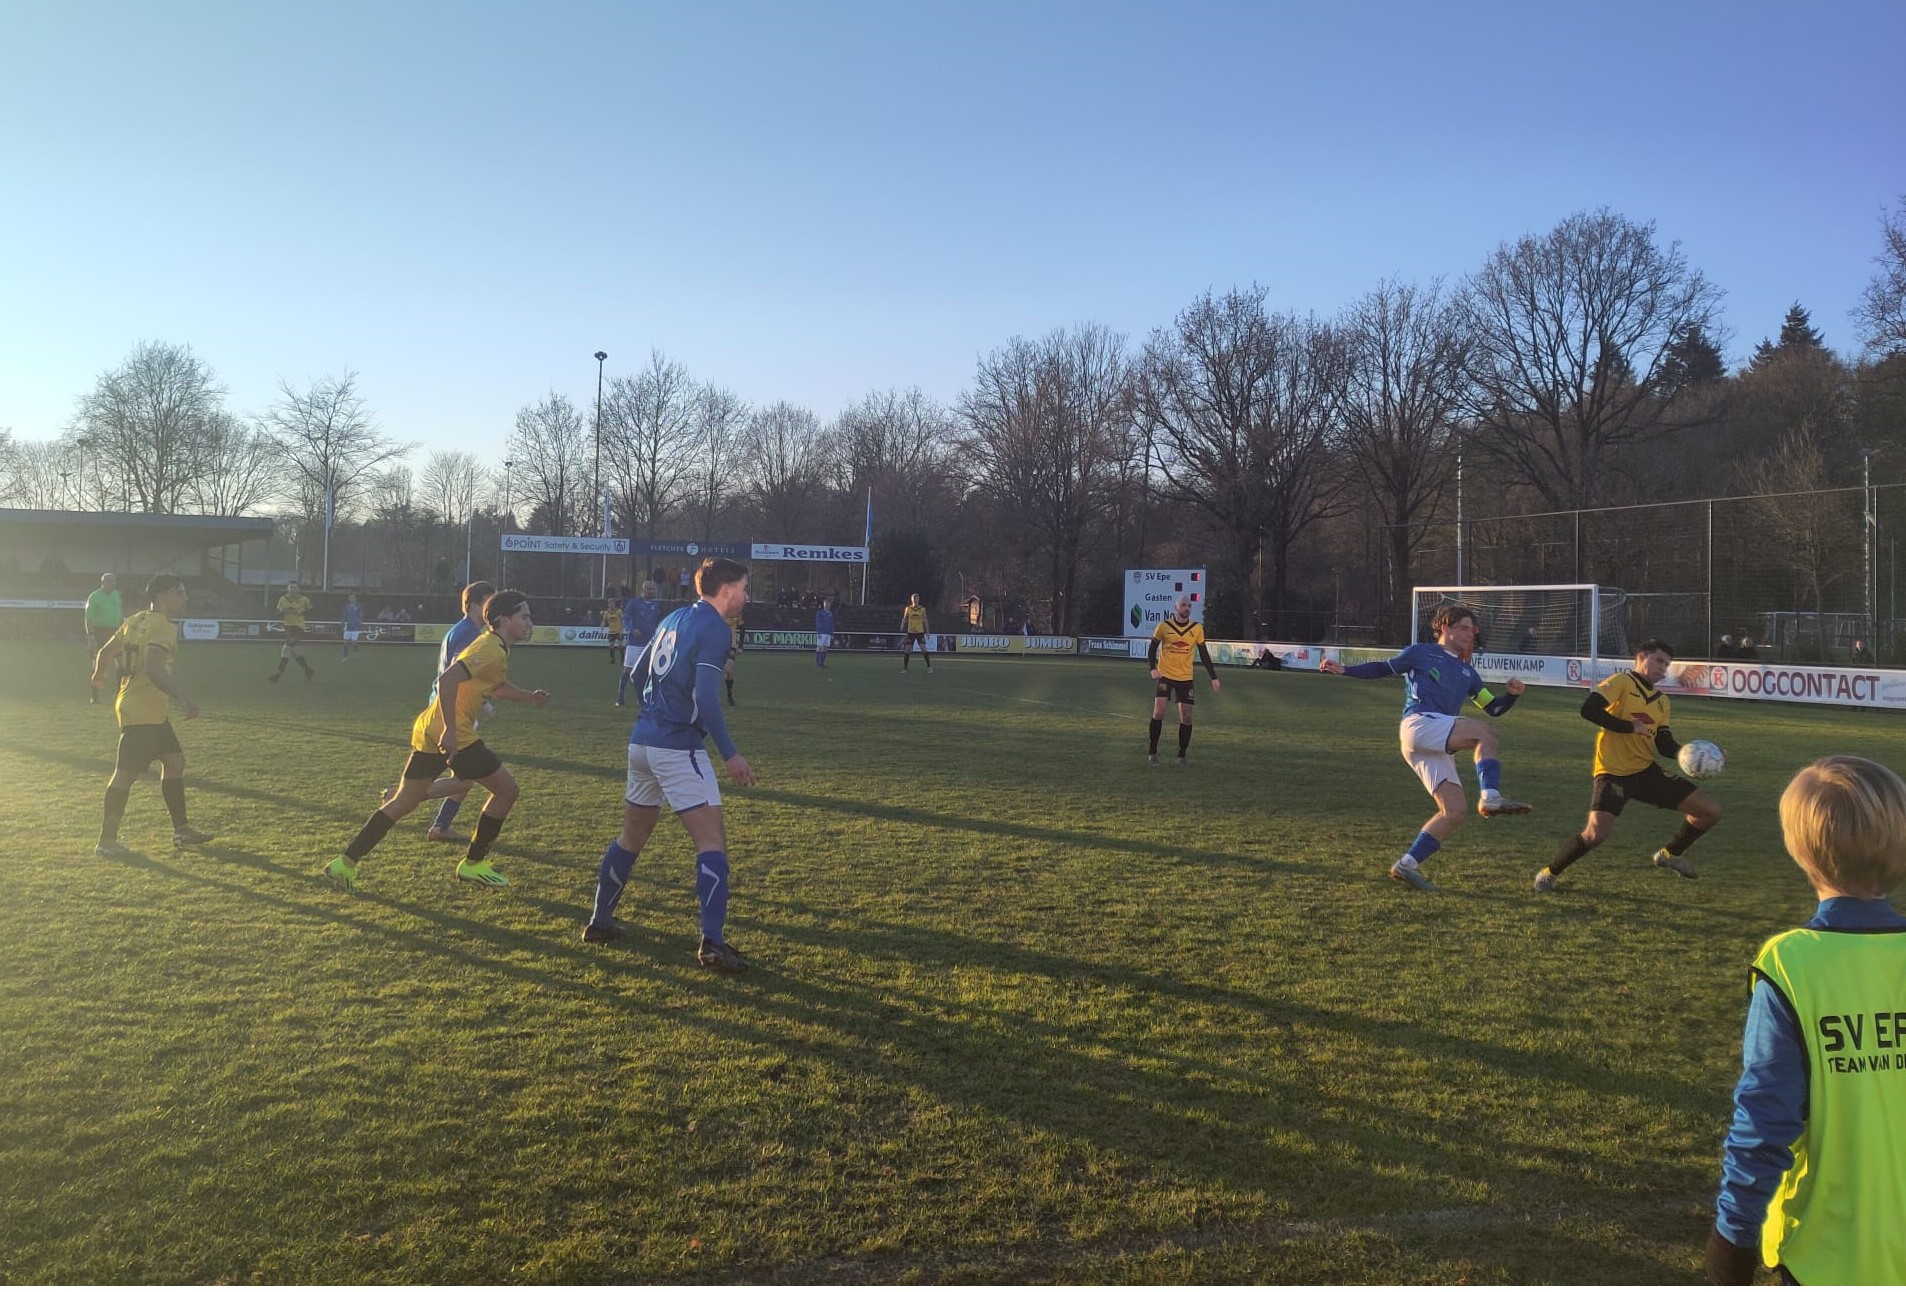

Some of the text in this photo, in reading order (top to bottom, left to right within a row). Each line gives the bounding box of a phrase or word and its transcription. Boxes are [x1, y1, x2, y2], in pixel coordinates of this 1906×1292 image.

[544, 541, 570, 551] Safety
[580, 543, 611, 552] Security
[783, 547, 863, 560] Remkes
[1145, 572, 1171, 582] SV Epe
[1145, 593, 1173, 602] Gasten
[1145, 609, 1161, 622] Van
[753, 632, 770, 645] DE
[961, 635, 1011, 648] JUMBO
[1025, 636, 1073, 649] JUMBO
[1732, 669, 1880, 701] OOGCONTACT
[1819, 1013, 1863, 1052] SV
[1828, 1057, 1867, 1073] TEAM
[1868, 1054, 1890, 1071] VAN
